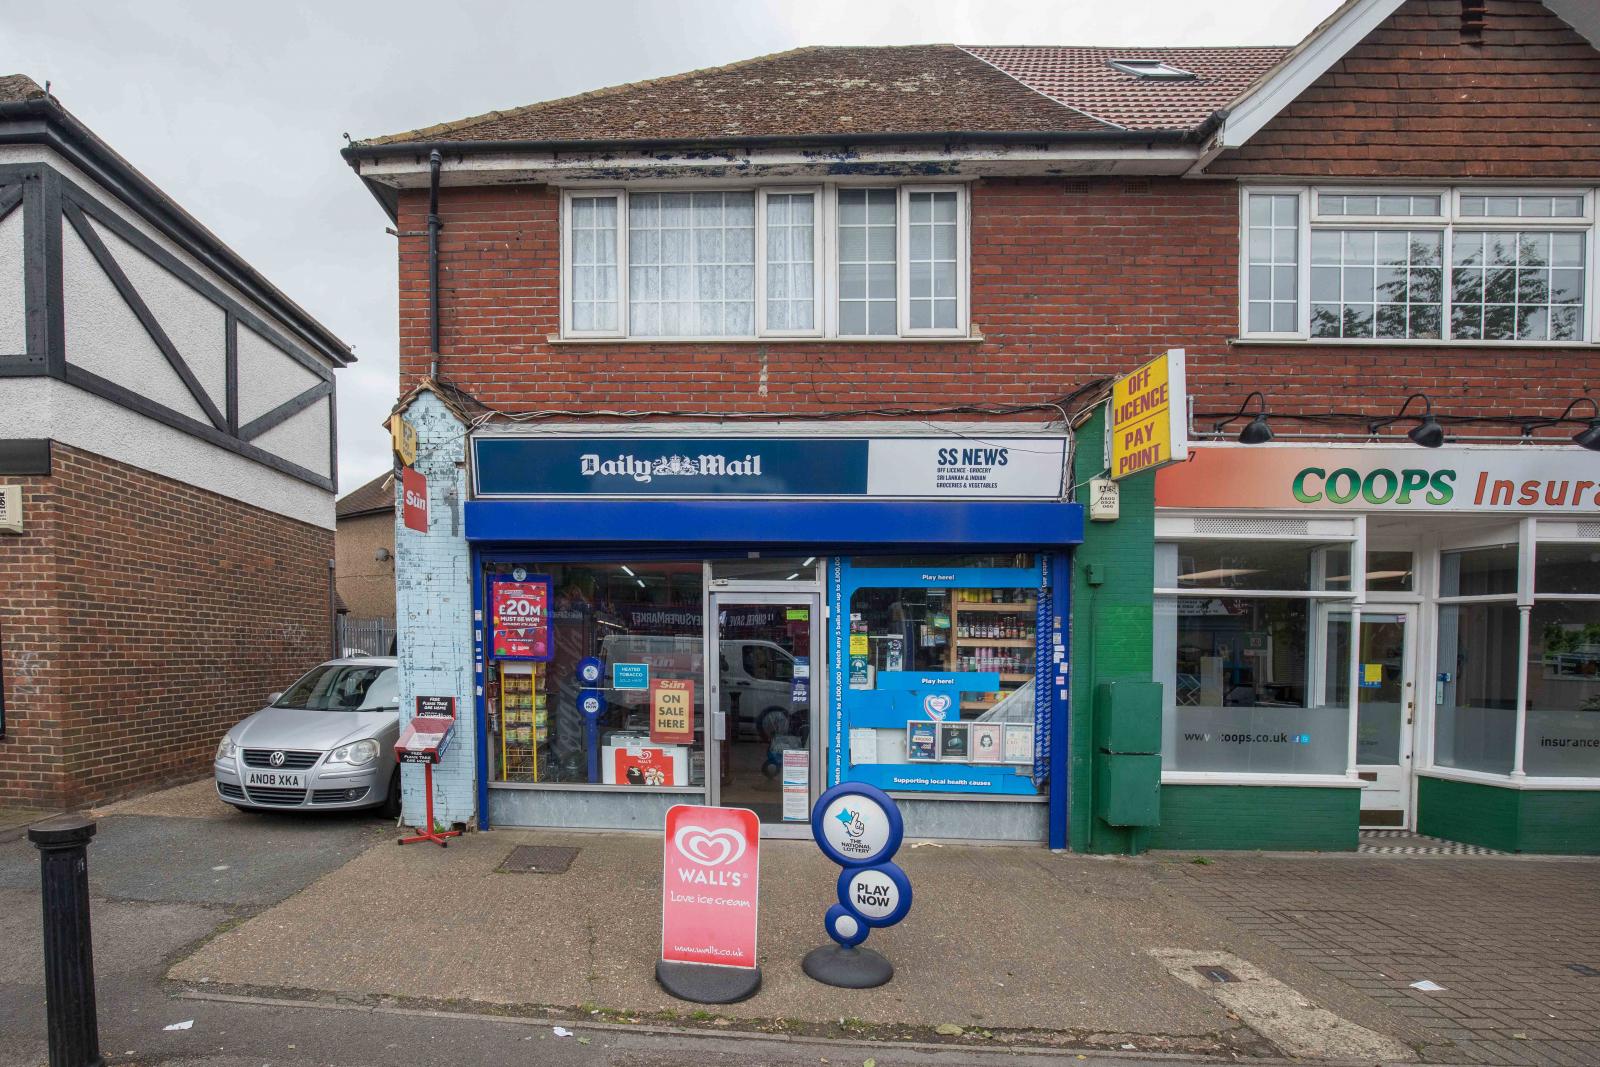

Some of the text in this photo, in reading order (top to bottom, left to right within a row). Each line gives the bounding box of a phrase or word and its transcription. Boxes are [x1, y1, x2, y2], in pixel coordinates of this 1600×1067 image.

[1128, 366, 1151, 396] OFF
[1114, 382, 1168, 426] LICENCE
[1124, 422, 1154, 450] PAY
[938, 448, 1008, 466] SS NEWS
[1120, 443, 1161, 474] POINT
[580, 453, 762, 483] Daily Mail
[1292, 467, 1456, 504] COOPS
[406, 490, 426, 511] Sun
[499, 599, 540, 616] £20M
[660, 680, 685, 689] Sun
[662, 695, 680, 703] ON
[659, 707, 684, 716] SALE
[658, 719, 684, 728] HERE
[1184, 732, 1288, 744] wwoops.co.uk
[1541, 736, 1599, 747] insurance
[250, 774, 298, 786] AN08 XKA
[678, 868, 741, 886] WALL'S
[857, 883, 889, 896] PLAY
[671, 890, 750, 908] Love ice cream
[857, 894, 890, 907] NOW
[674, 945, 743, 956] www.walls.co.uk
